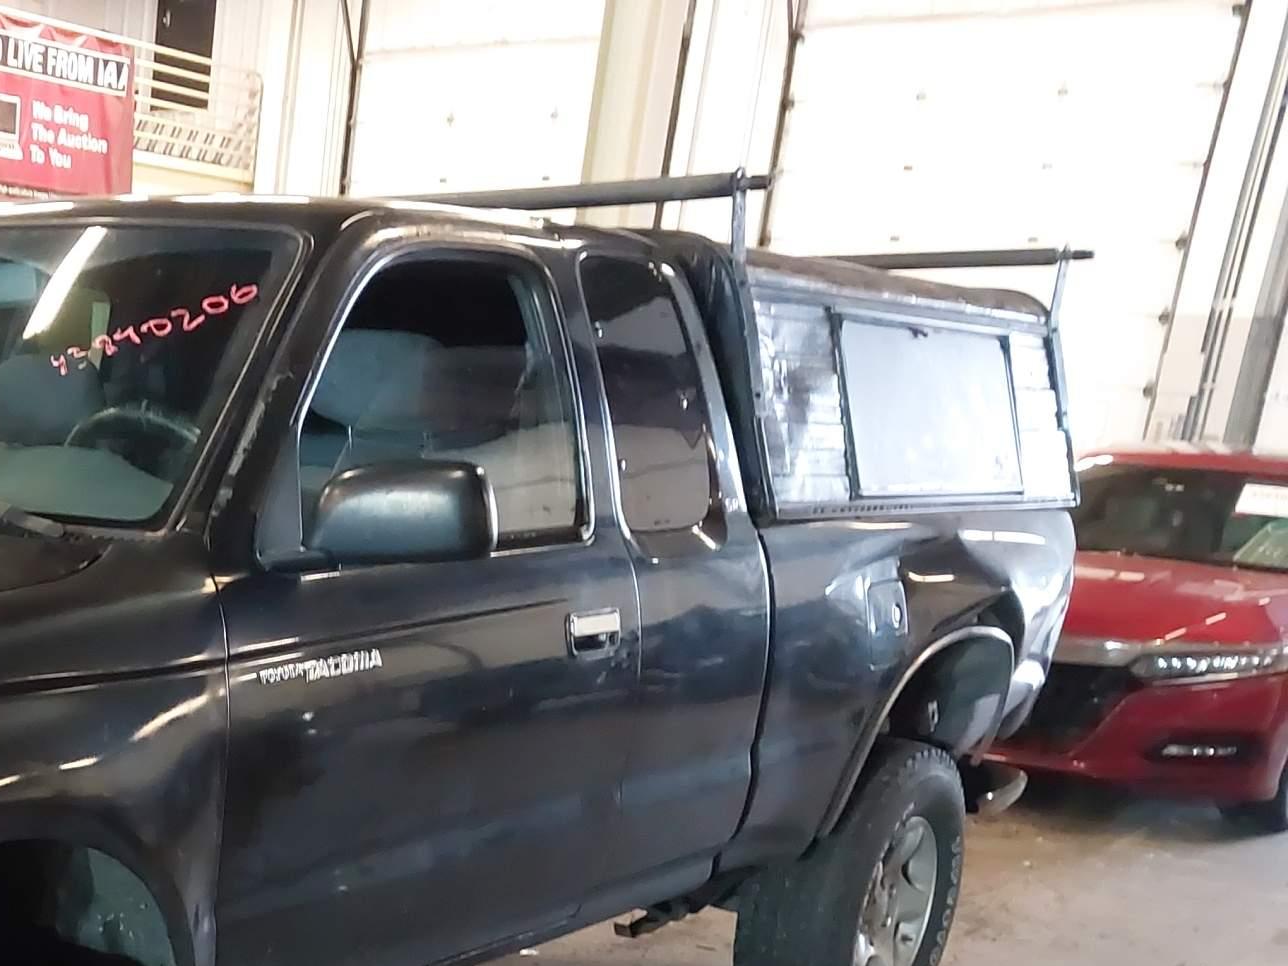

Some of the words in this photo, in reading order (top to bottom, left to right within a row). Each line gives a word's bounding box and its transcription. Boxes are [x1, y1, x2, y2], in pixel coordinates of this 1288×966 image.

[7, 36, 46, 74] LIVE
[47, 46, 94, 85] FROM
[32, 99, 52, 122] We
[54, 104, 88, 133] Bring
[31, 122, 55, 145] The
[57, 127, 108, 155] Auction
[29, 144, 45, 165] To
[48, 147, 72, 169] You
[303, 648, 383, 684] TACOMA
